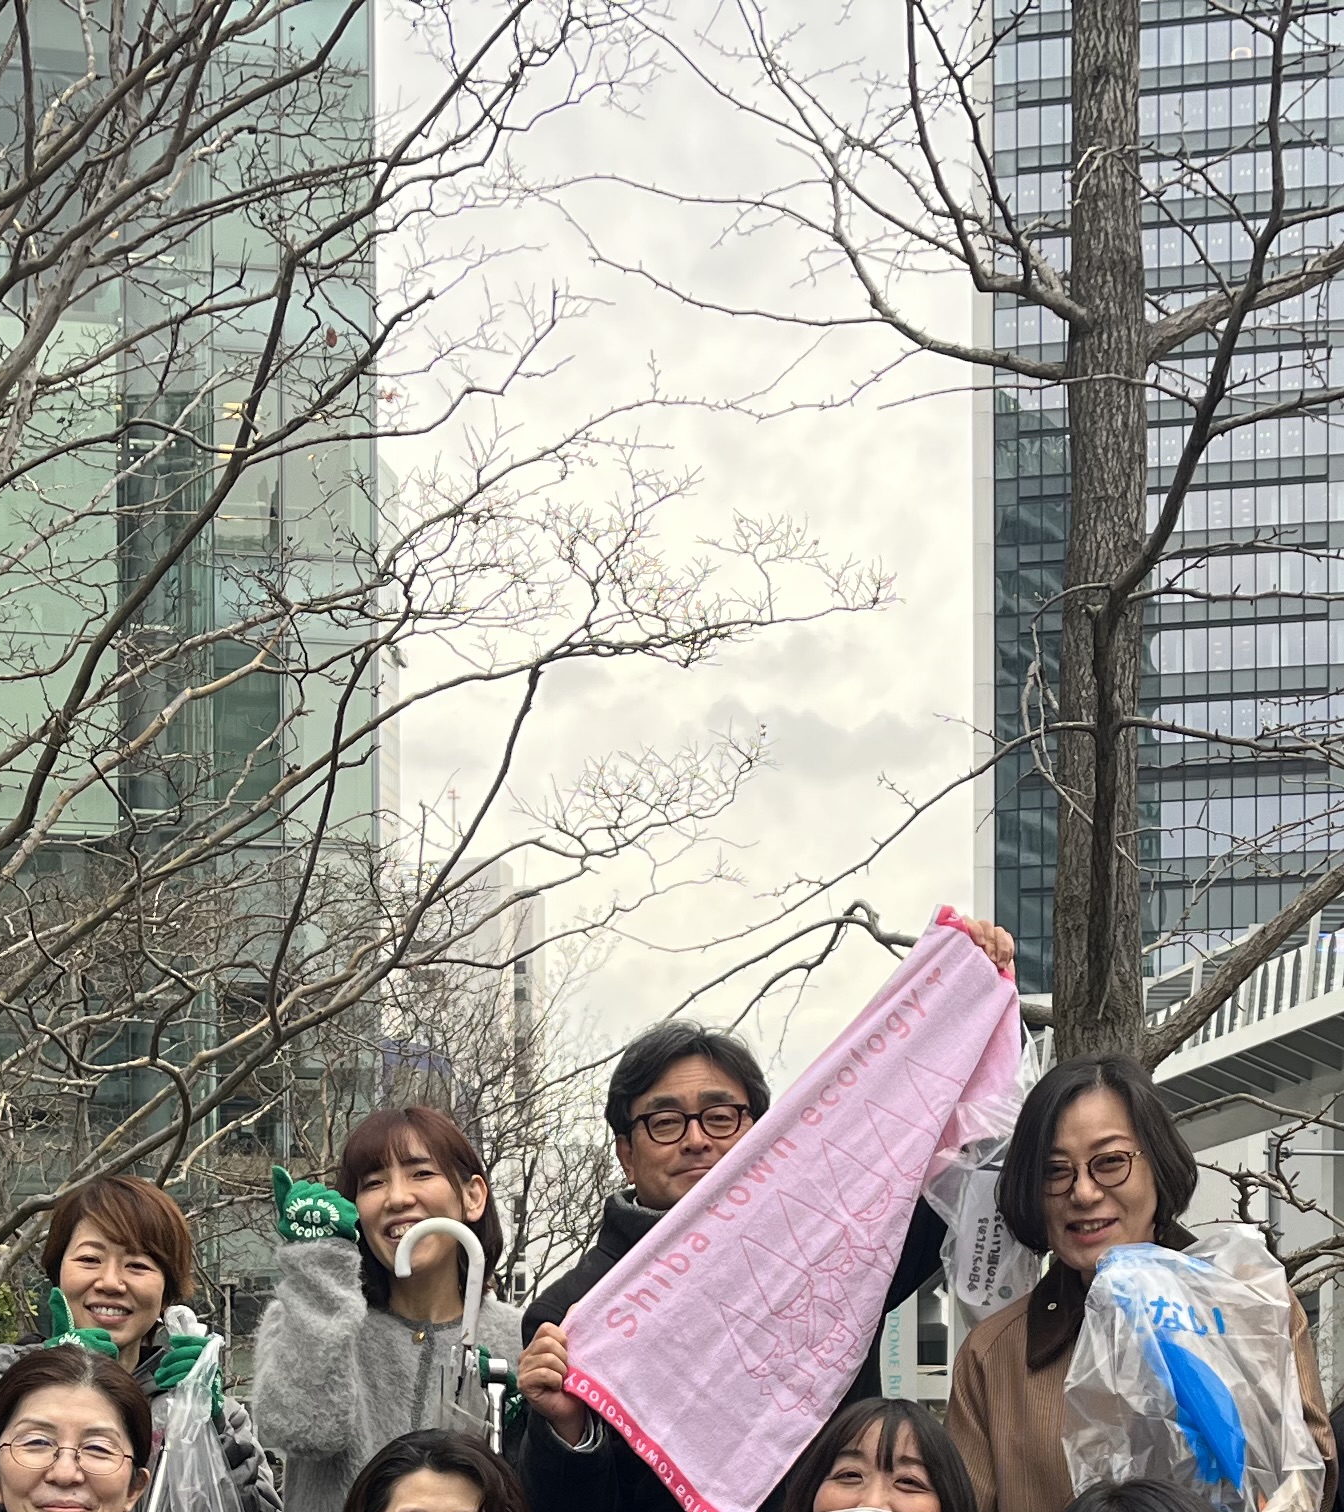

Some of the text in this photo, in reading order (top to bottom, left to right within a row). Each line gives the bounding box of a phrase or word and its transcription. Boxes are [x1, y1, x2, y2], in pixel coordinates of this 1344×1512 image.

[606, 994, 929, 1339] Shiba town ecology
[289, 1221, 338, 1238] ecology
[303, 1210, 321, 1224] 48
[563, 1372, 633, 1438] ecology
[632, 1438, 674, 1484] town
